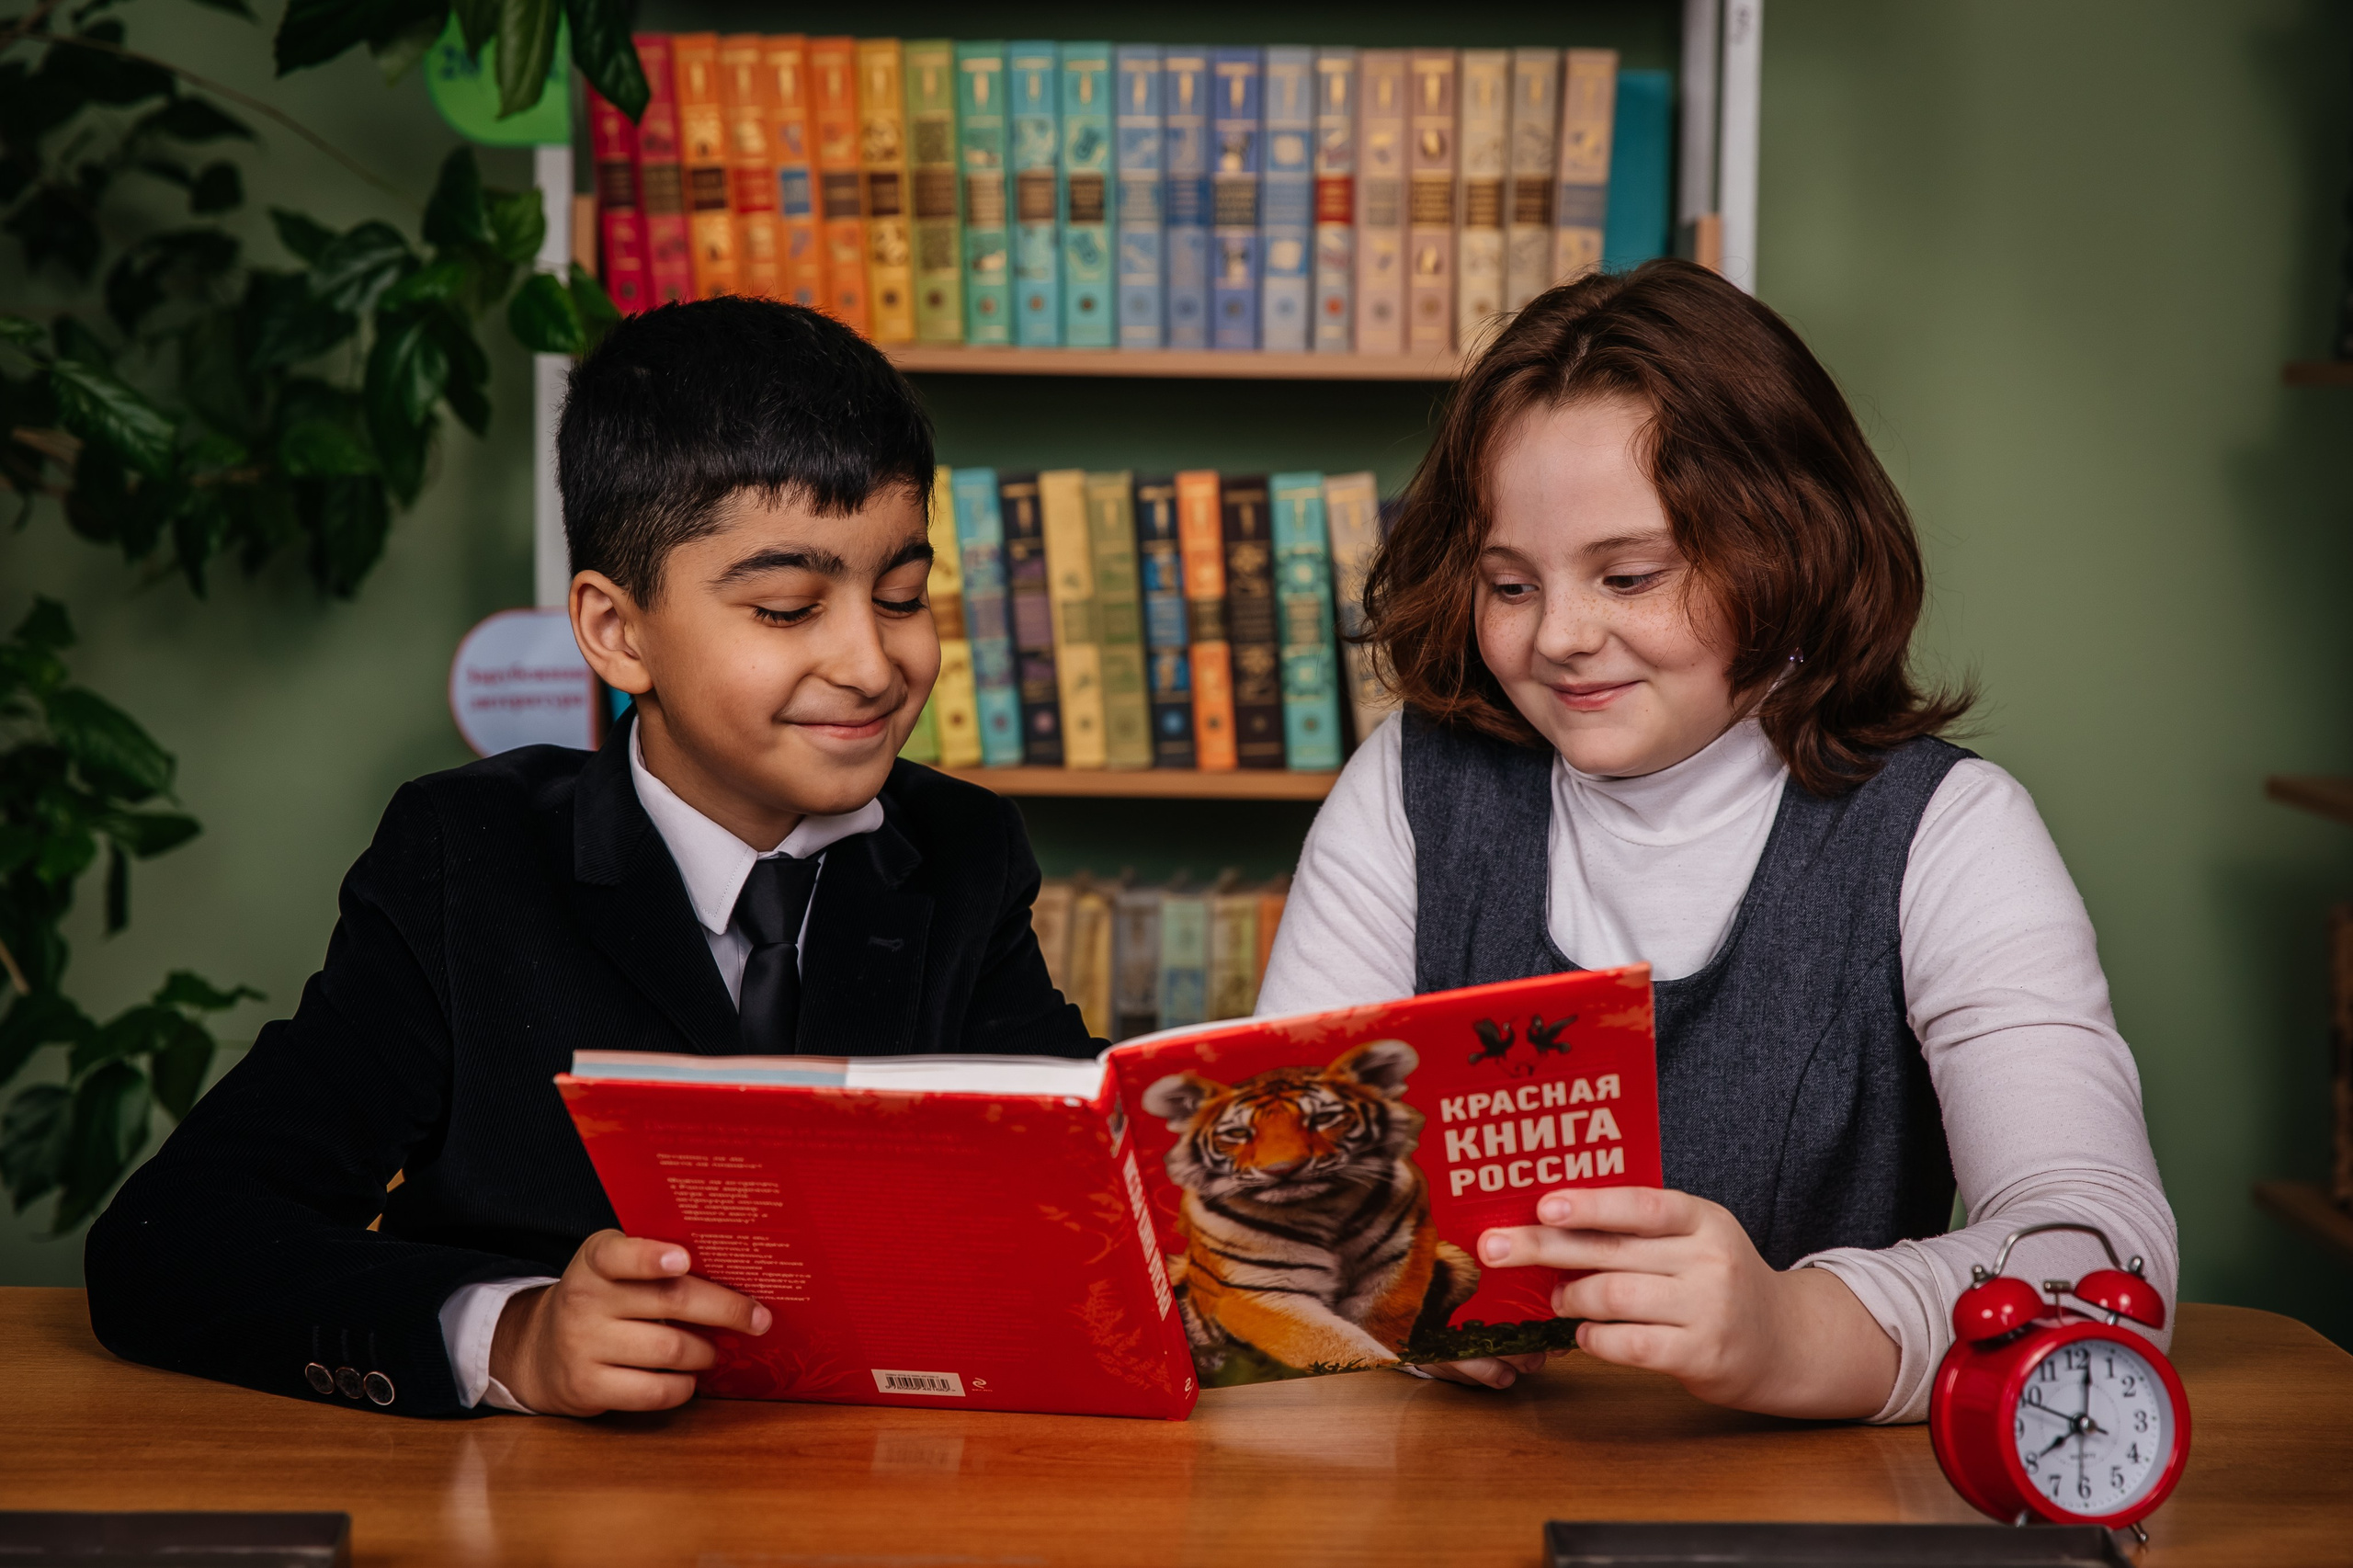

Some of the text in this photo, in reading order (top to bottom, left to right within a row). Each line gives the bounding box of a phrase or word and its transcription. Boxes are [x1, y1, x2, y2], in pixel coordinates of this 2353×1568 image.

[1440, 1074, 1620, 1123] КРАСНАЯ
[1444, 1107, 1622, 1163] КНИГА
[1449, 1146, 1625, 1197] РОССИИ
[2039, 1359, 2057, 1382] 11
[2064, 1348, 2090, 1370] 12
[2105, 1358, 2116, 1379] 1
[2121, 1376, 2137, 1398] 2
[2133, 1410, 2148, 1433] 3
[2025, 1451, 2040, 1475] 8
[2127, 1442, 2142, 1464] 4
[2048, 1473, 2062, 1497] 7
[2078, 1476, 2092, 1499] 6
[2110, 1465, 2125, 1489] 5
